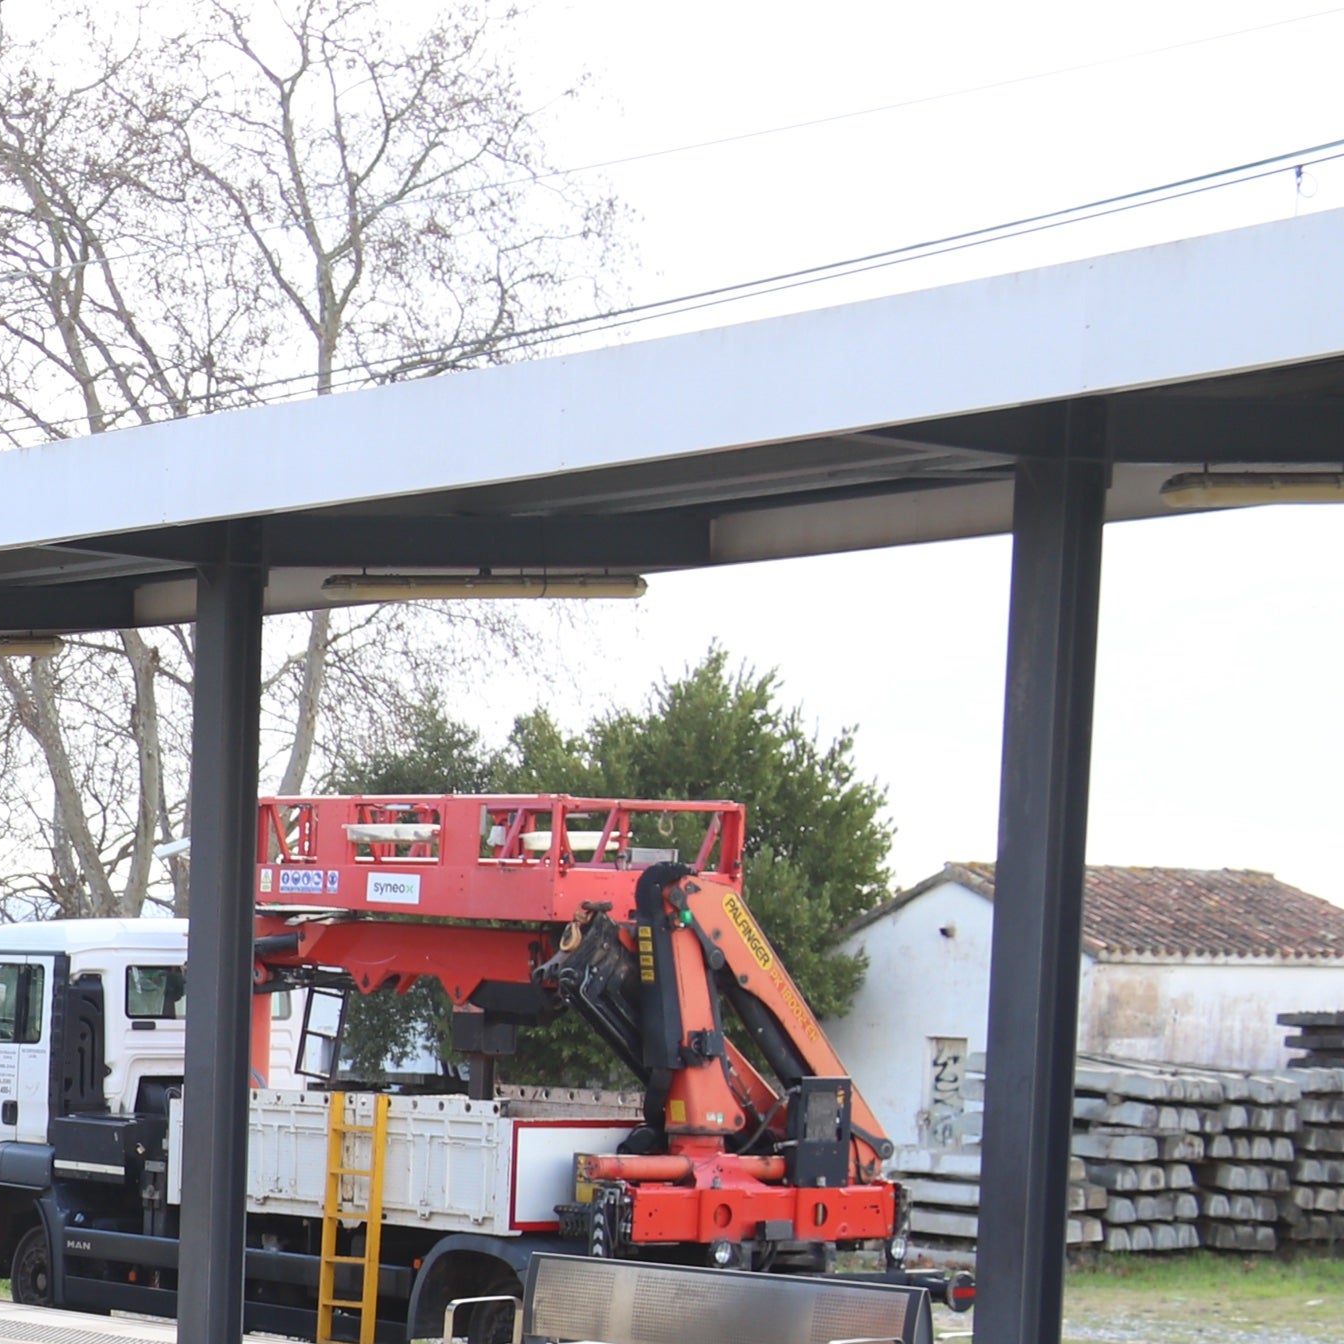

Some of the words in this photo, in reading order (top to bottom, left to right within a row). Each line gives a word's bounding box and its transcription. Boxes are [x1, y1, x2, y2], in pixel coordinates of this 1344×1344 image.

[373, 881, 415, 895] syneox
[725, 898, 770, 967] PALFINGER
[770, 969, 783, 987] PK
[66, 1239, 92, 1250] MAN
